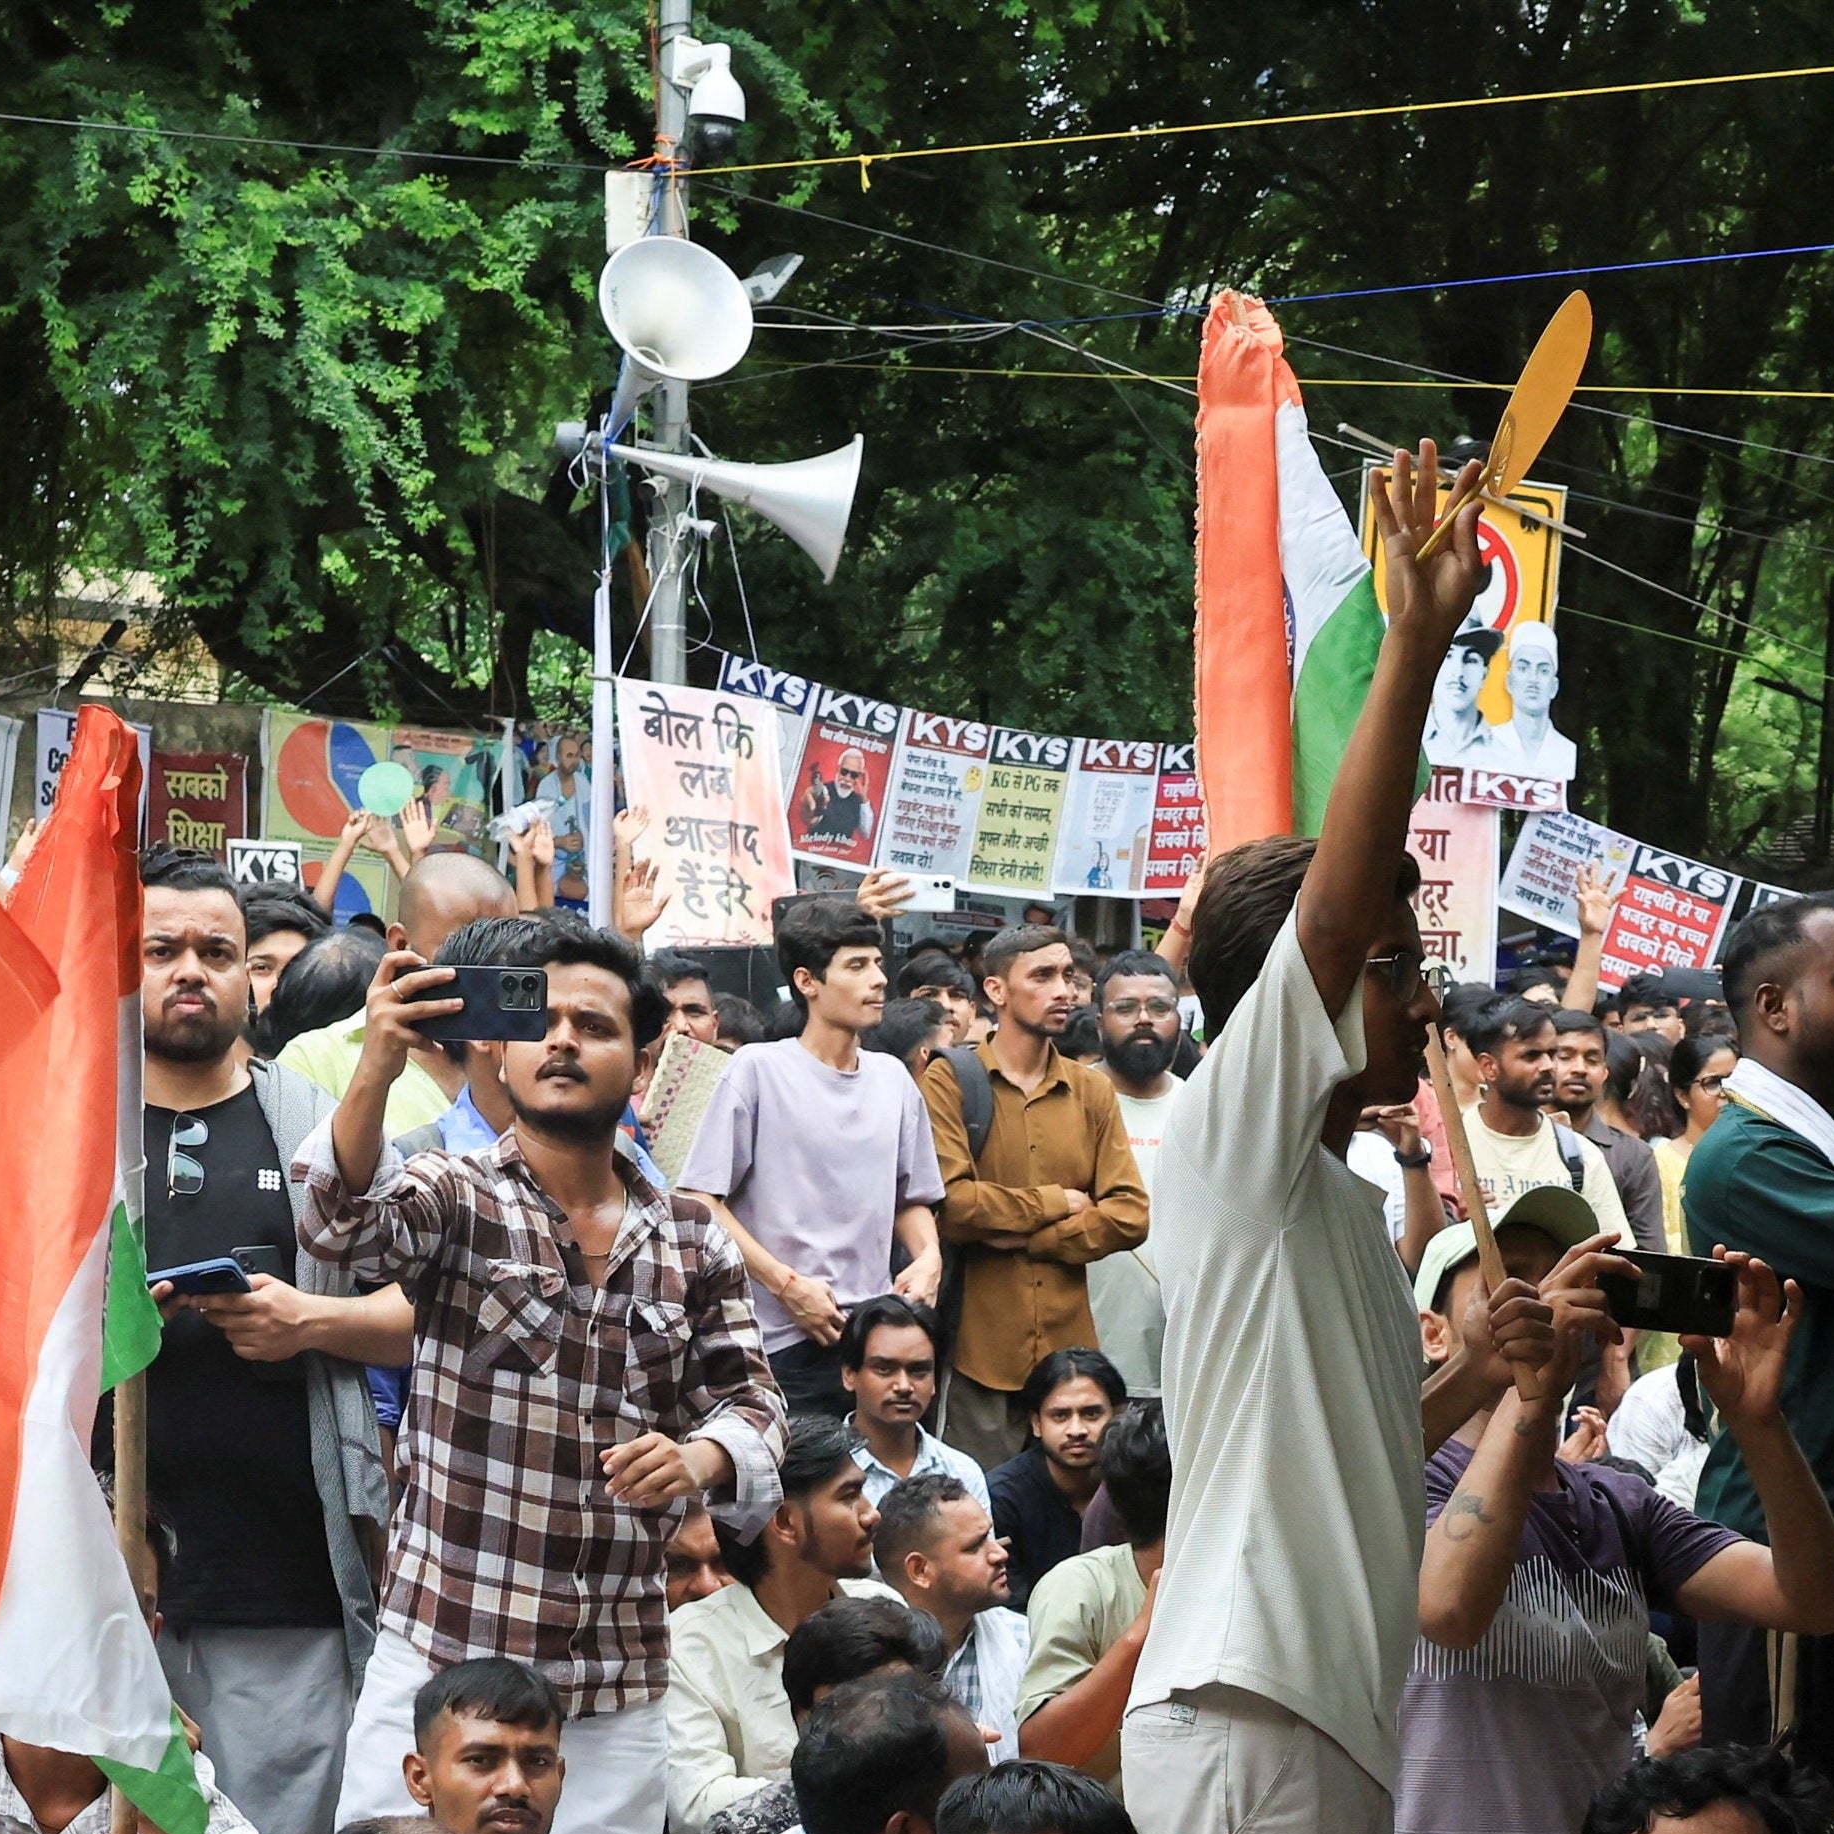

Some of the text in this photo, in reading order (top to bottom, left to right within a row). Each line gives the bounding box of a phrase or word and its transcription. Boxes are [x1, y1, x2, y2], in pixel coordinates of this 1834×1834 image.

[726, 655, 807, 707] KYS
[640, 691, 754, 760] बोल कि
[817, 689, 898, 734] KYS
[913, 712, 988, 751] KYS
[995, 732, 1068, 765] KYS
[1085, 739, 1155, 769] KYS
[164, 764, 229, 800] सबको
[675, 760, 734, 799] लब
[991, 770, 1061, 793] KG से PG तक
[1476, 773, 1560, 806] KYS
[986, 798, 1008, 817] सभी
[1009, 801, 1022, 819] को
[166, 808, 226, 850] शिक्षा
[664, 815, 762, 865] आज़ाद
[1002, 828, 1020, 850] और
[234, 850, 299, 883] KYS
[970, 854, 997, 879] शिक्षा
[1636, 848, 1728, 899] KYS
[675, 858, 709, 920] हैं
[1515, 885, 1565, 914] जवाब दो!
[1694, 907, 1712, 924] या
[1617, 929, 1661, 960] सबको
